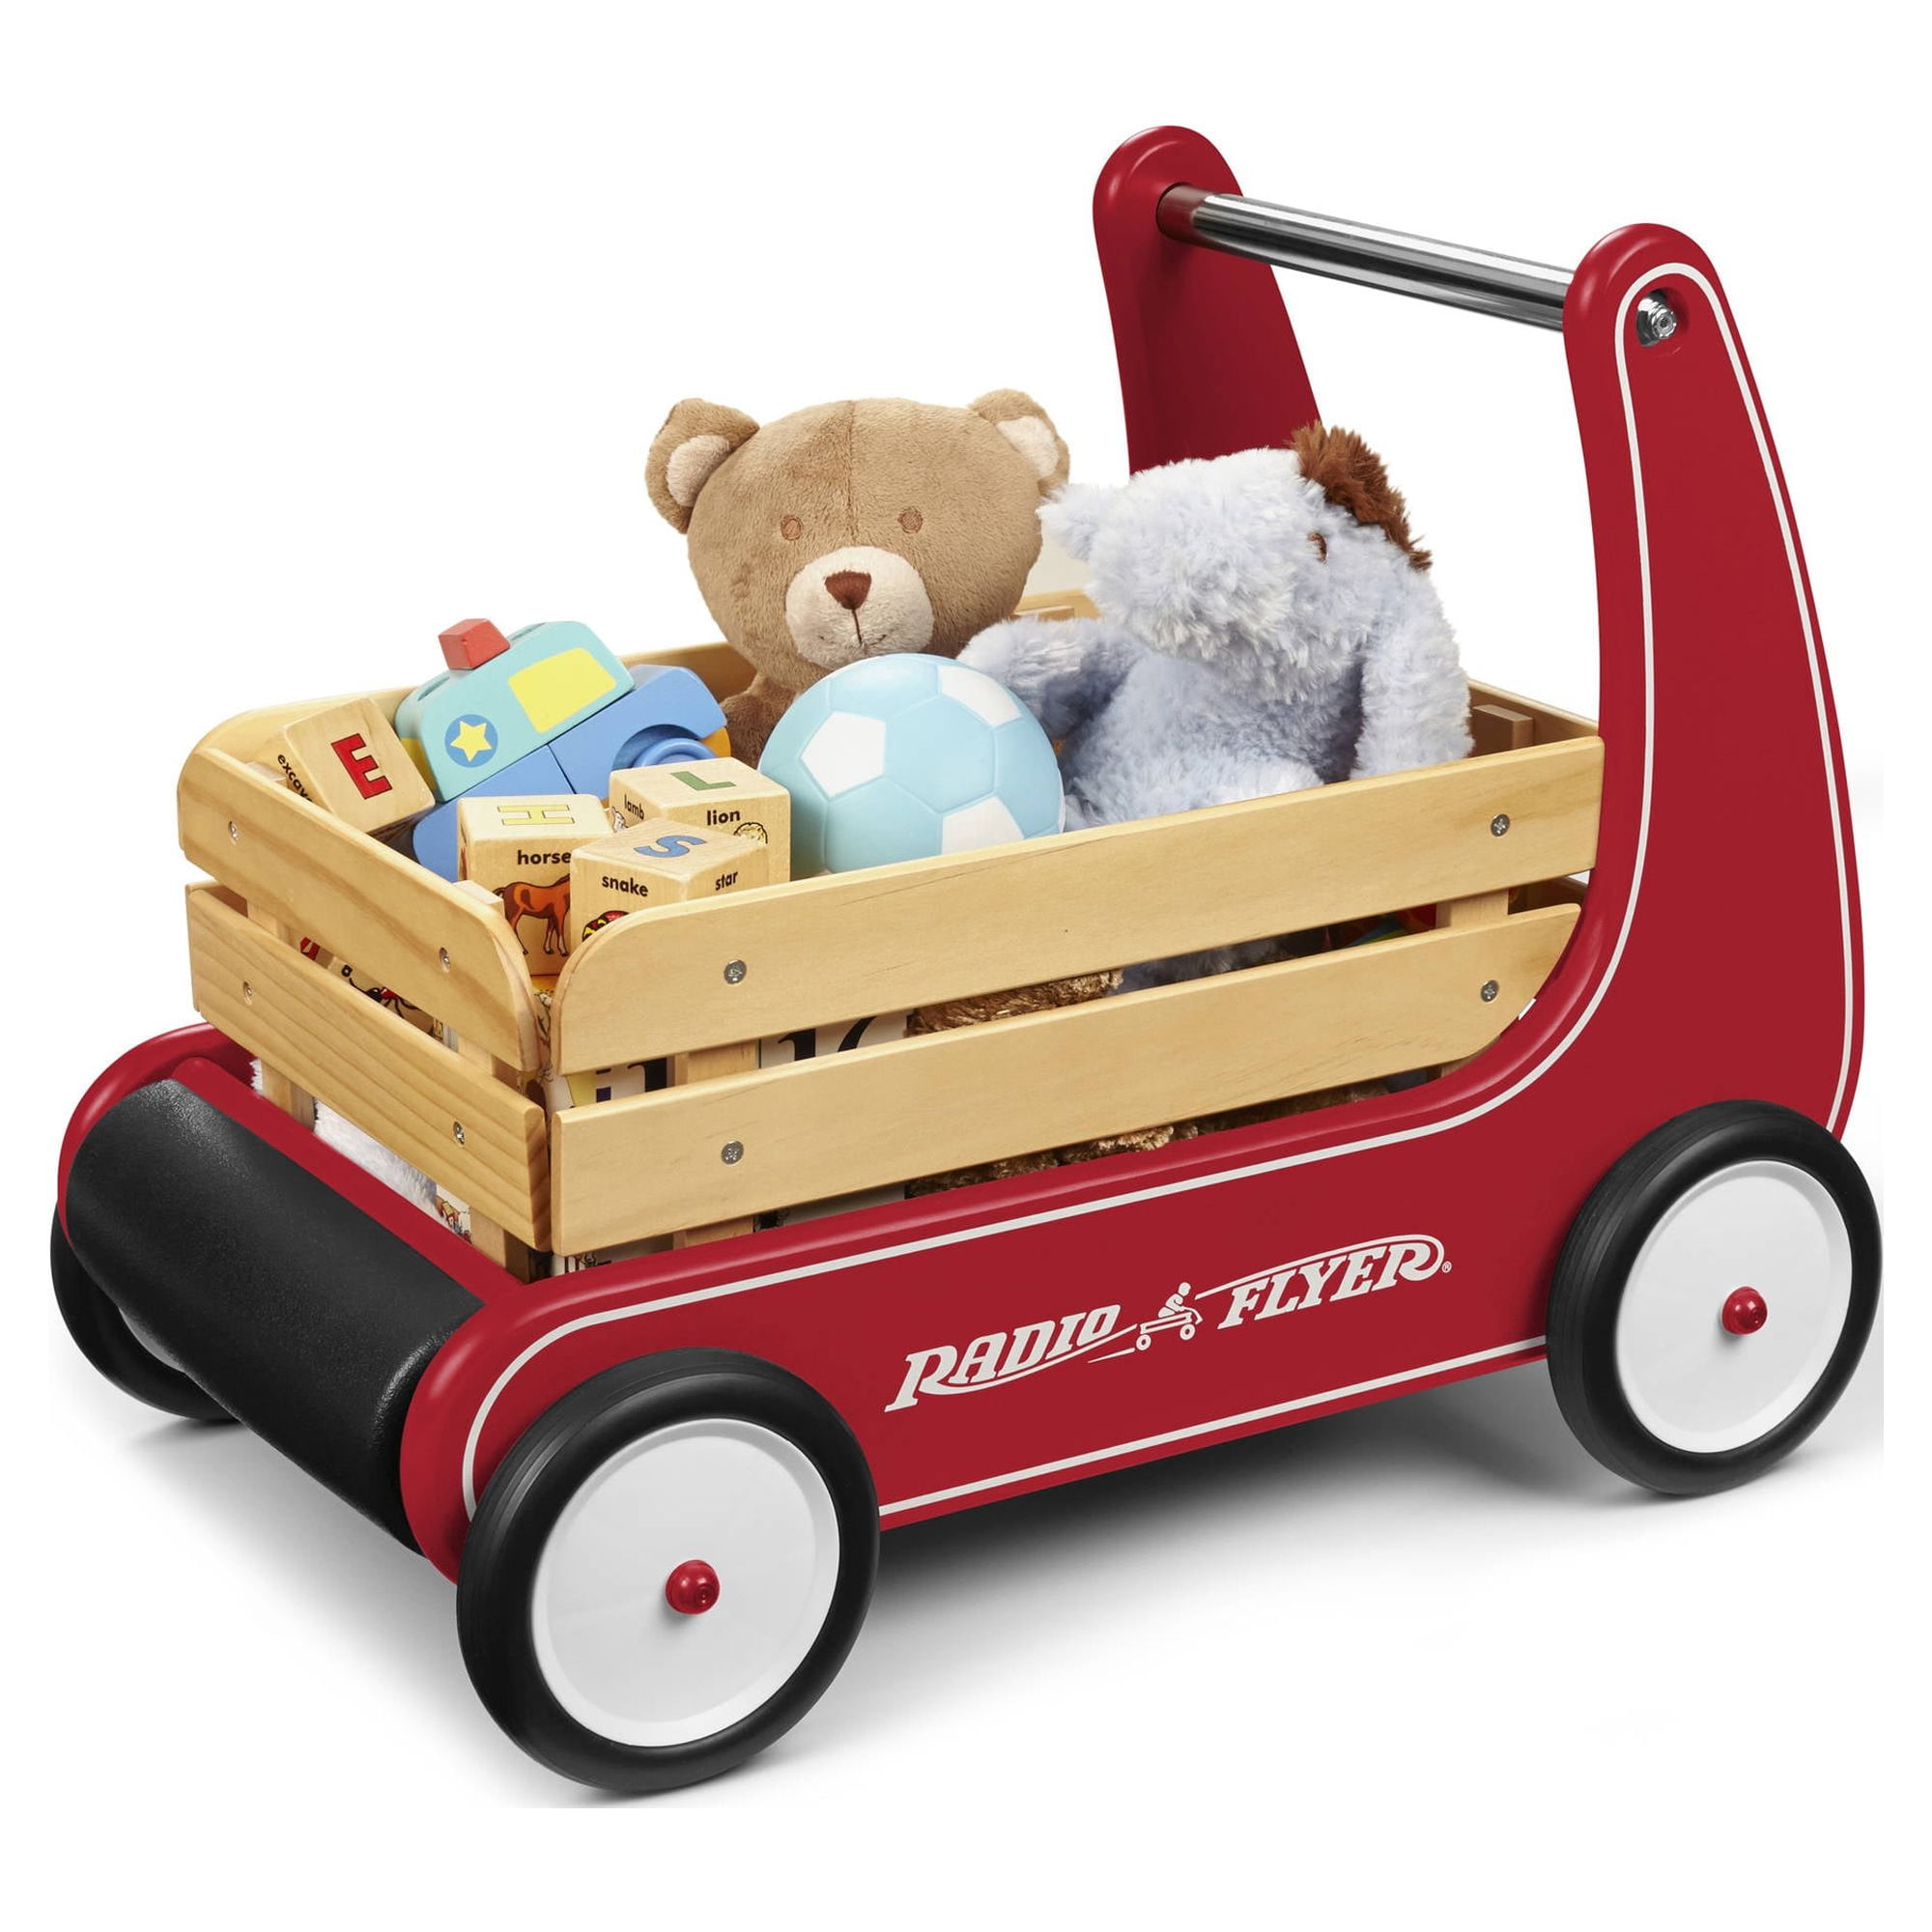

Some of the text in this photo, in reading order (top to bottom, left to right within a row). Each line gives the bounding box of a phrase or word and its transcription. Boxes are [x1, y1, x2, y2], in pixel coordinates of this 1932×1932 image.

[330, 733, 393, 800] E
[277, 754, 313, 802] excav
[669, 771, 736, 791] L
[497, 804, 576, 825] H
[624, 794, 644, 820] lamb
[707, 810, 741, 826] lion
[517, 849, 571, 866] horse
[634, 835, 708, 858] S
[602, 875, 649, 897] snake
[715, 871, 738, 891] star
[884, 1304, 1124, 1412] RADIO
